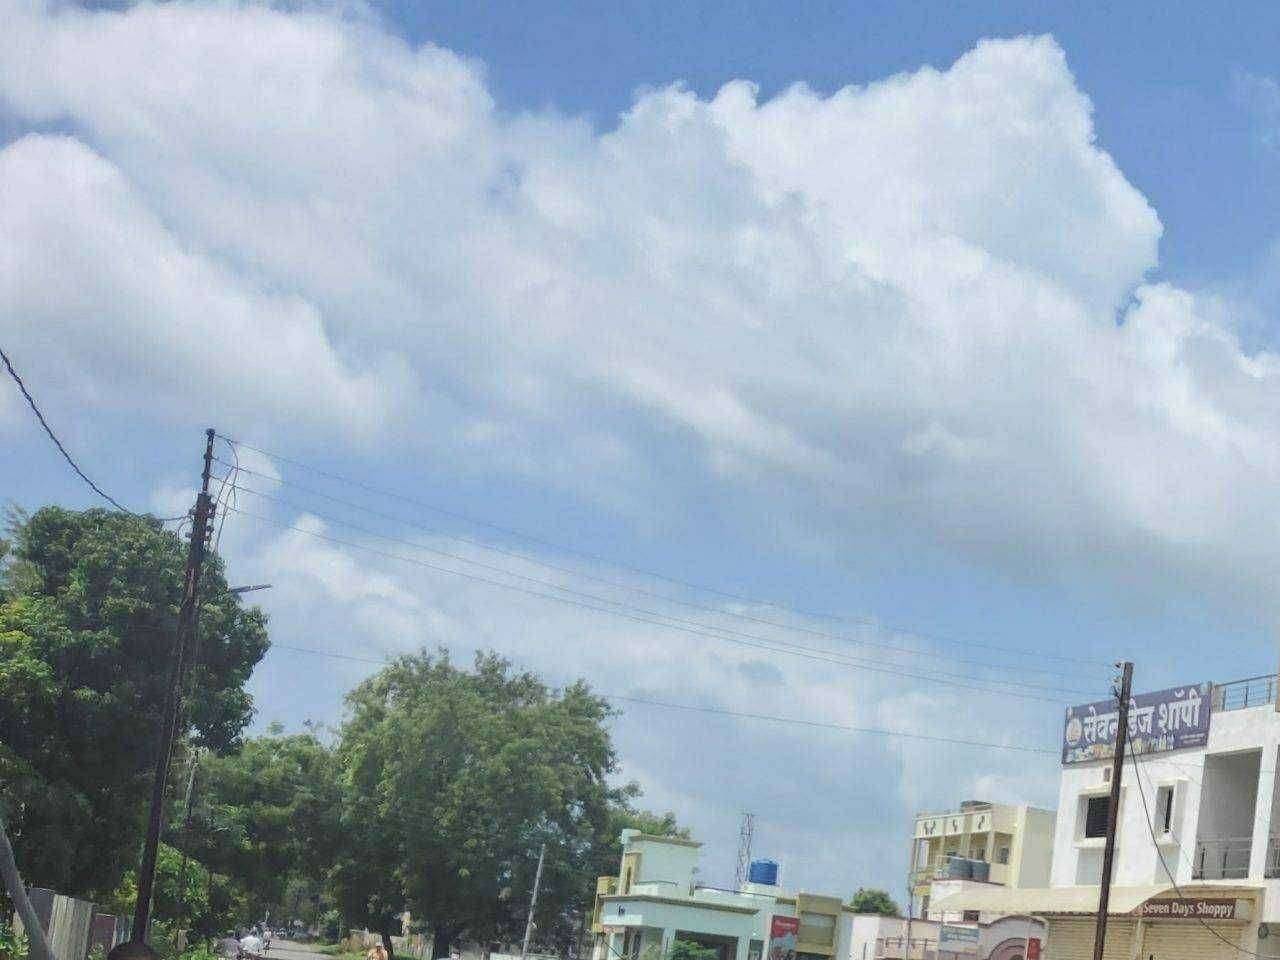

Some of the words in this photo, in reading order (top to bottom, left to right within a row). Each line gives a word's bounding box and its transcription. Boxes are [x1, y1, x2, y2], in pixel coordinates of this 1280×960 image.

[1144, 902, 1170, 914] Seven
[1172, 902, 1195, 917] Days
[1196, 902, 1234, 918] Shoppy
